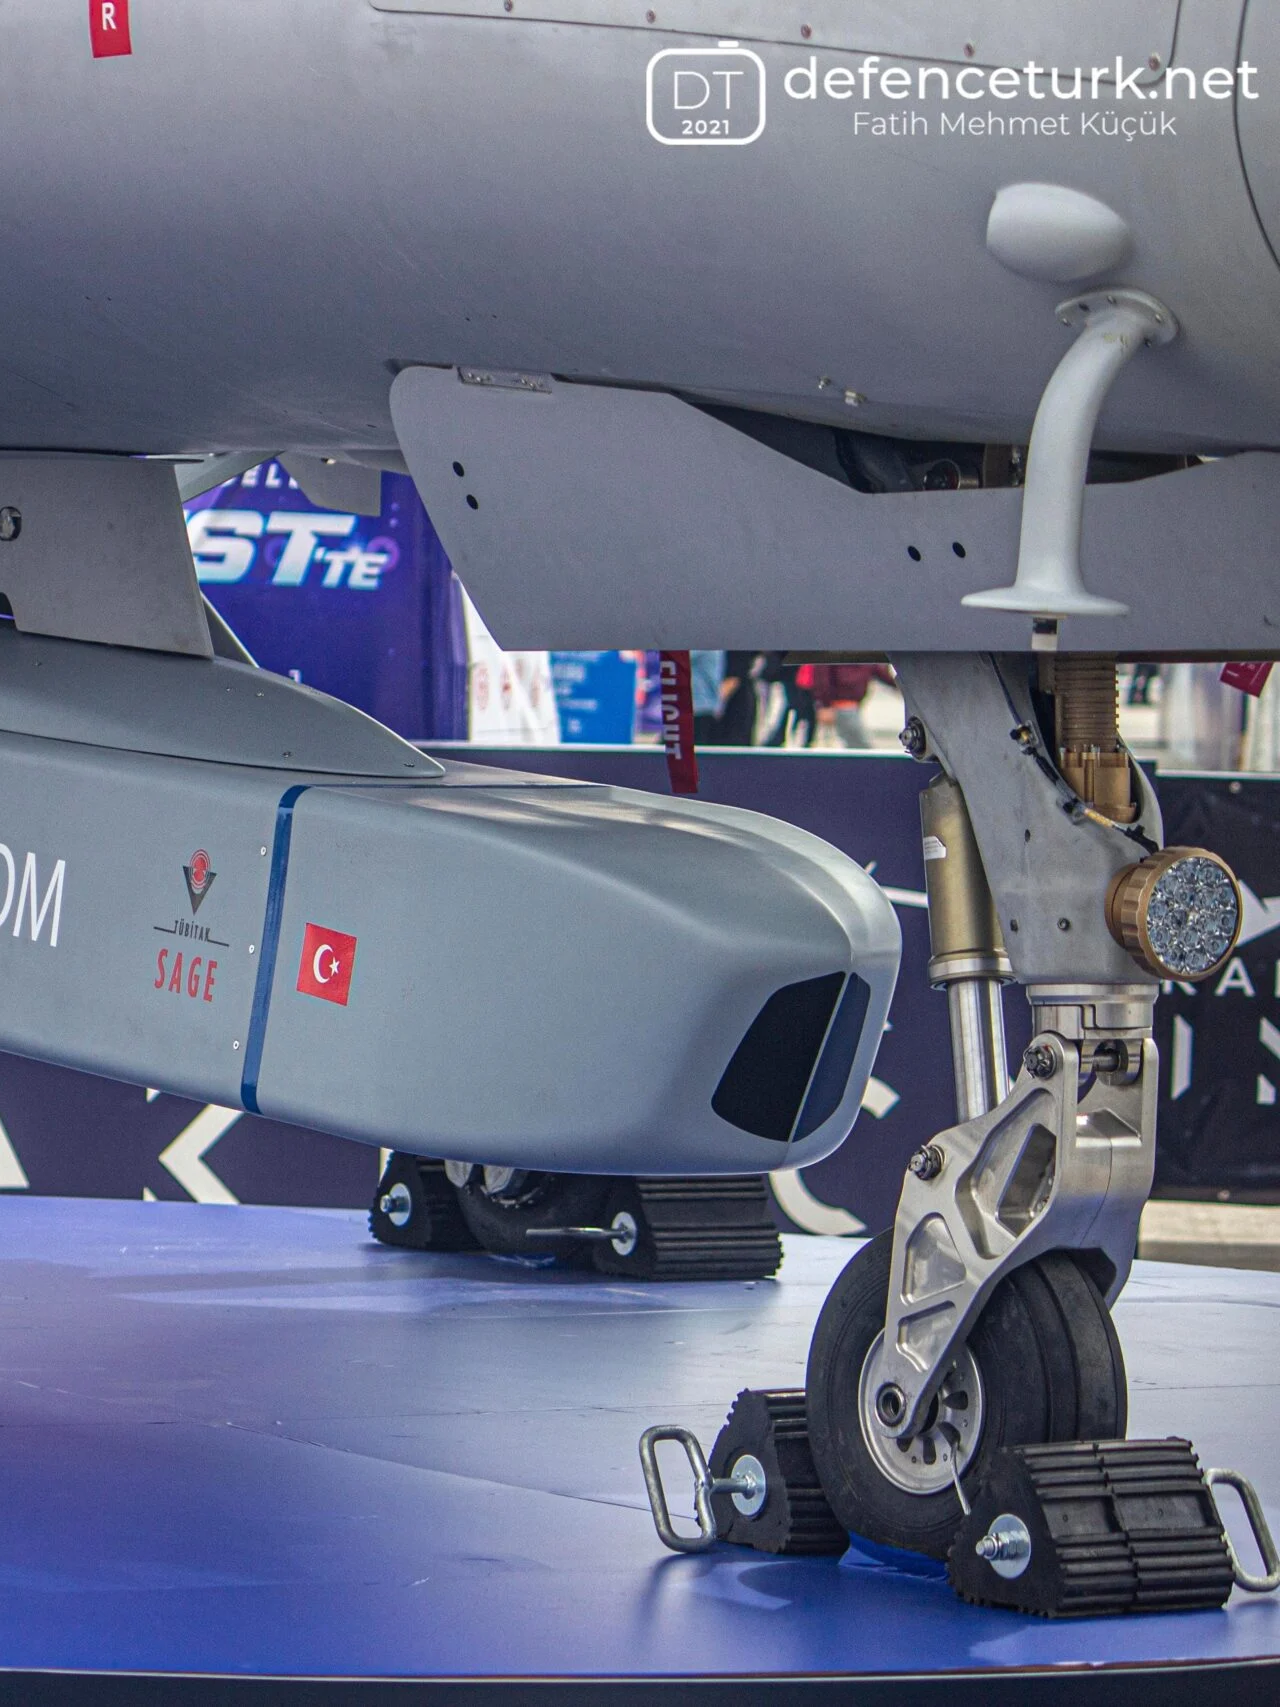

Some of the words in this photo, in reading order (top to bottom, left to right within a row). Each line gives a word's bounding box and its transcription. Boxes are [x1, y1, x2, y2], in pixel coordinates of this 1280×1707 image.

[182, 509, 388, 590] ST'TE
[173, 918, 211, 943] TÜBİTAK
[154, 948, 218, 1003] SAGE
